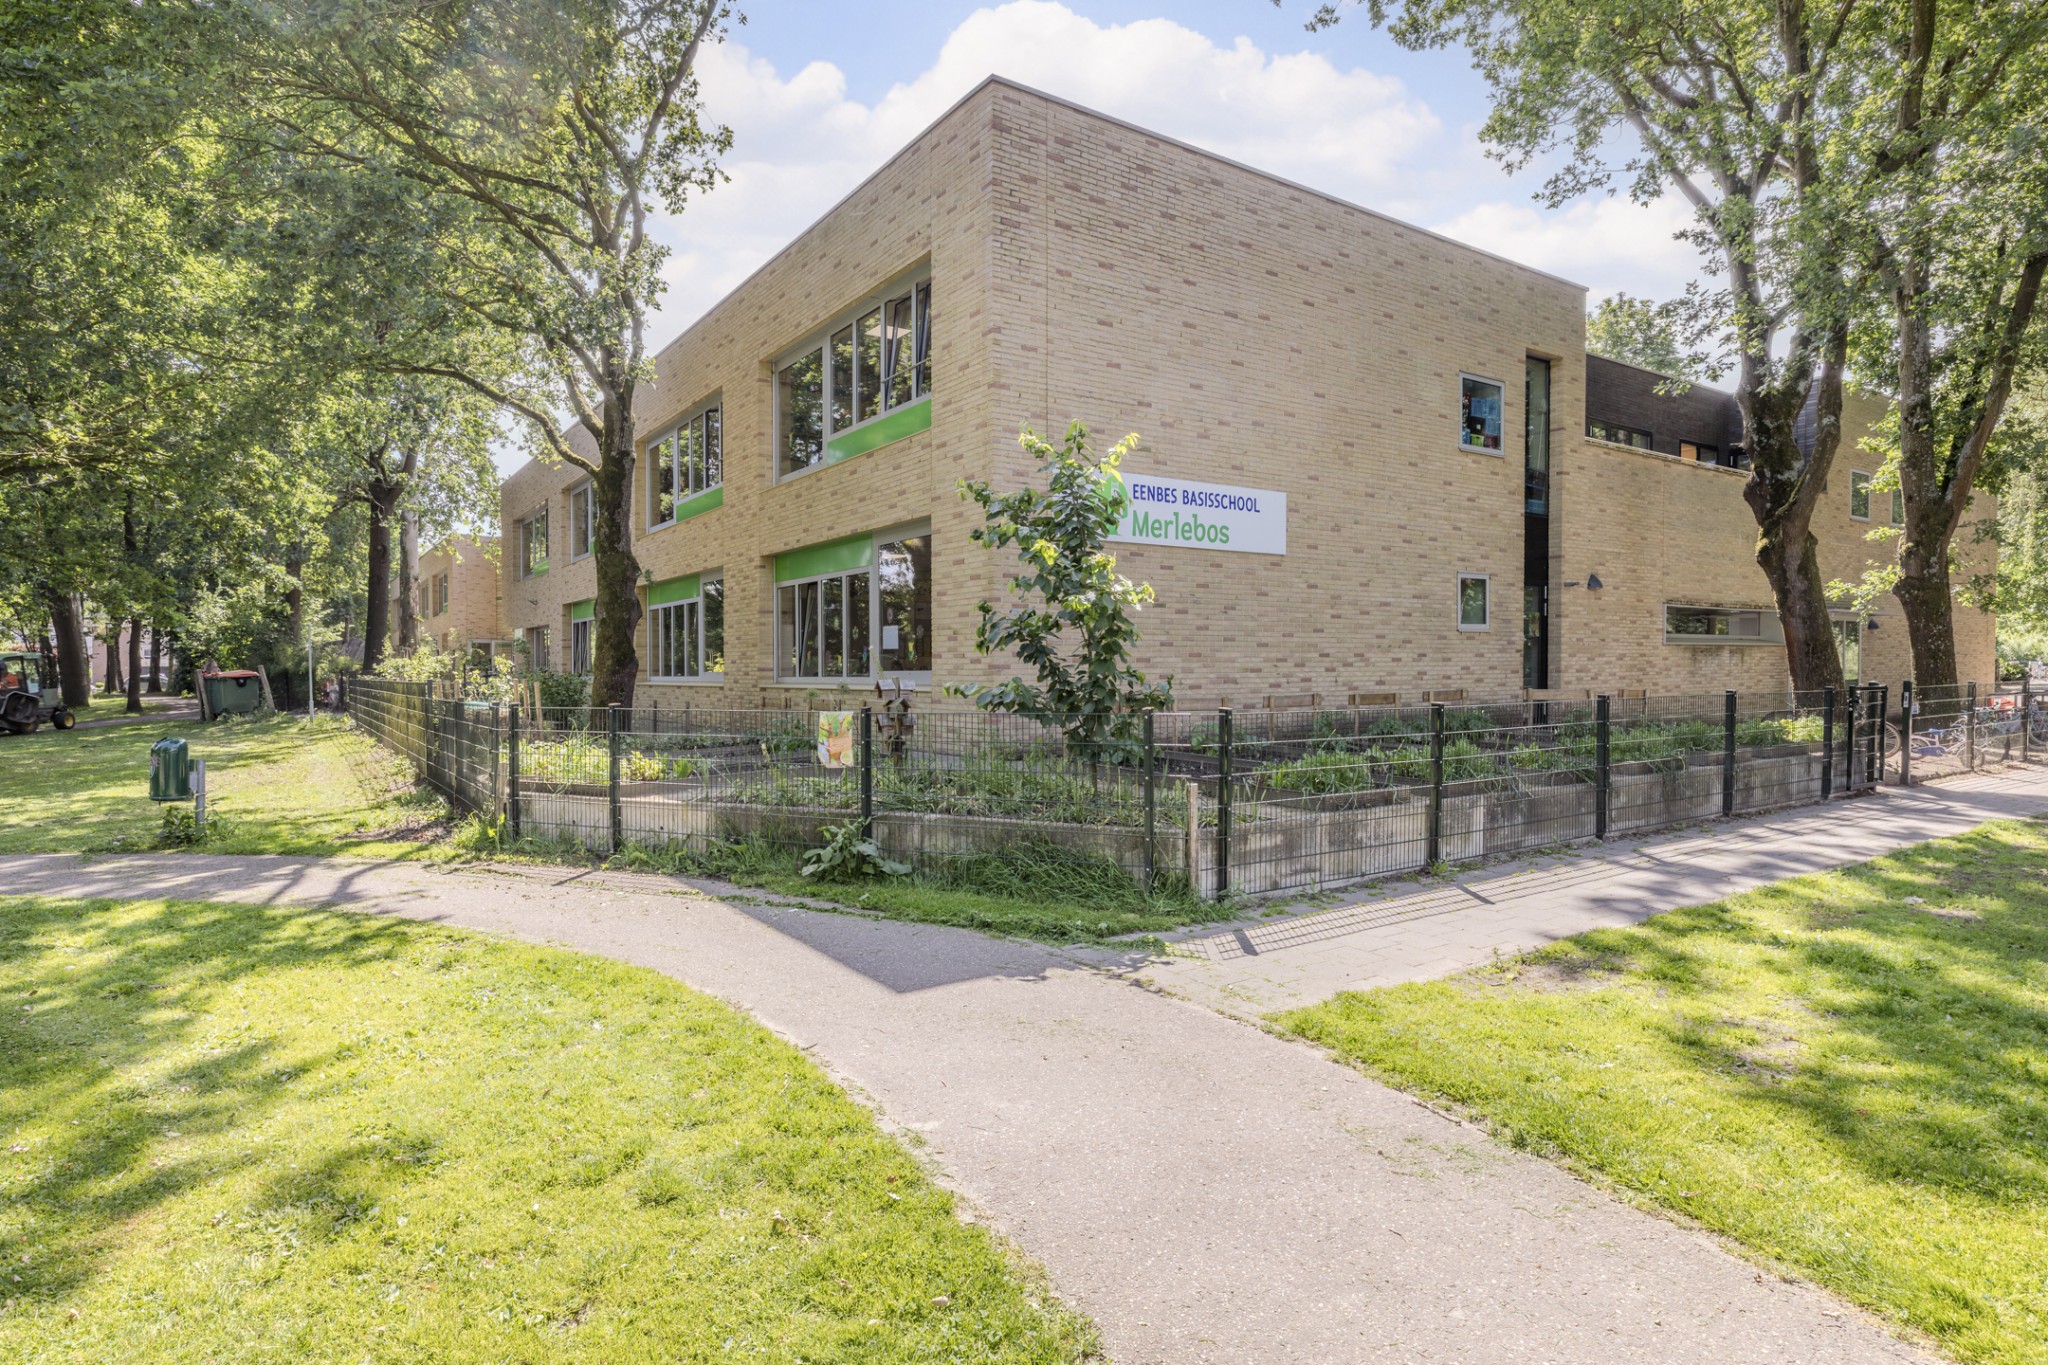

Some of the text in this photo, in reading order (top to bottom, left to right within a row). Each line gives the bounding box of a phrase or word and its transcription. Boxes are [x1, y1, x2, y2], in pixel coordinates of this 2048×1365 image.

[1132, 483, 1261, 513] EENBES BASISSCHOOL
[1131, 510, 1230, 545] Merlebos
